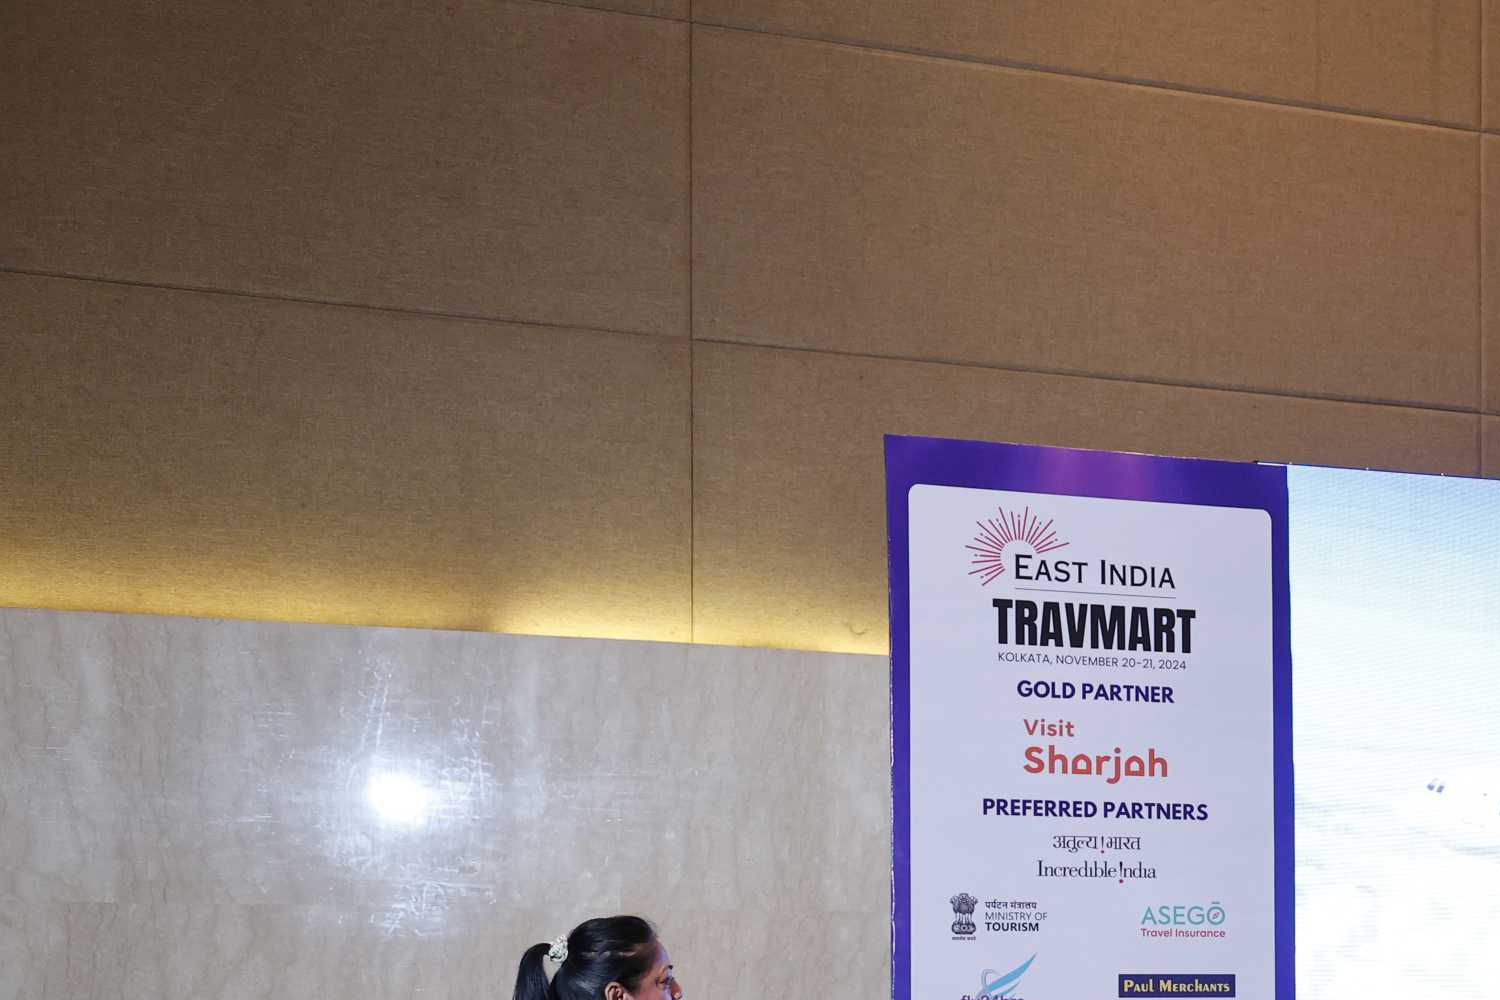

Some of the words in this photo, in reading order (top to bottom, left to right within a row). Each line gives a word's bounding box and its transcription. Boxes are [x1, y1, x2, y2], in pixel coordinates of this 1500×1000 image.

[1014, 554, 1088, 584] EAST
[1100, 559, 1176, 589] INDIA
[992, 598, 1196, 653] TRAVMART
[998, 652, 1053, 666] KOLKATA,
[1056, 653, 1118, 668] NOVEMBER
[1122, 657, 1156, 670] 20-21,
[1158, 659, 1186, 670] 2024
[1017, 680, 1075, 699] GOLD
[1082, 682, 1174, 704] PARTNER
[1024, 719, 1075, 737] Visit
[1024, 745, 1168, 784] Sharjah
[982, 798, 1097, 818] PREFERRED
[1103, 802, 1208, 820] PARTNERS
[985, 912, 1032, 920] MINISTRY
[1034, 912, 1048, 920] OF
[985, 922, 1040, 932] TOURISM
[1140, 928, 1172, 937] Travel
[1175, 928, 1226, 938] Insurance
